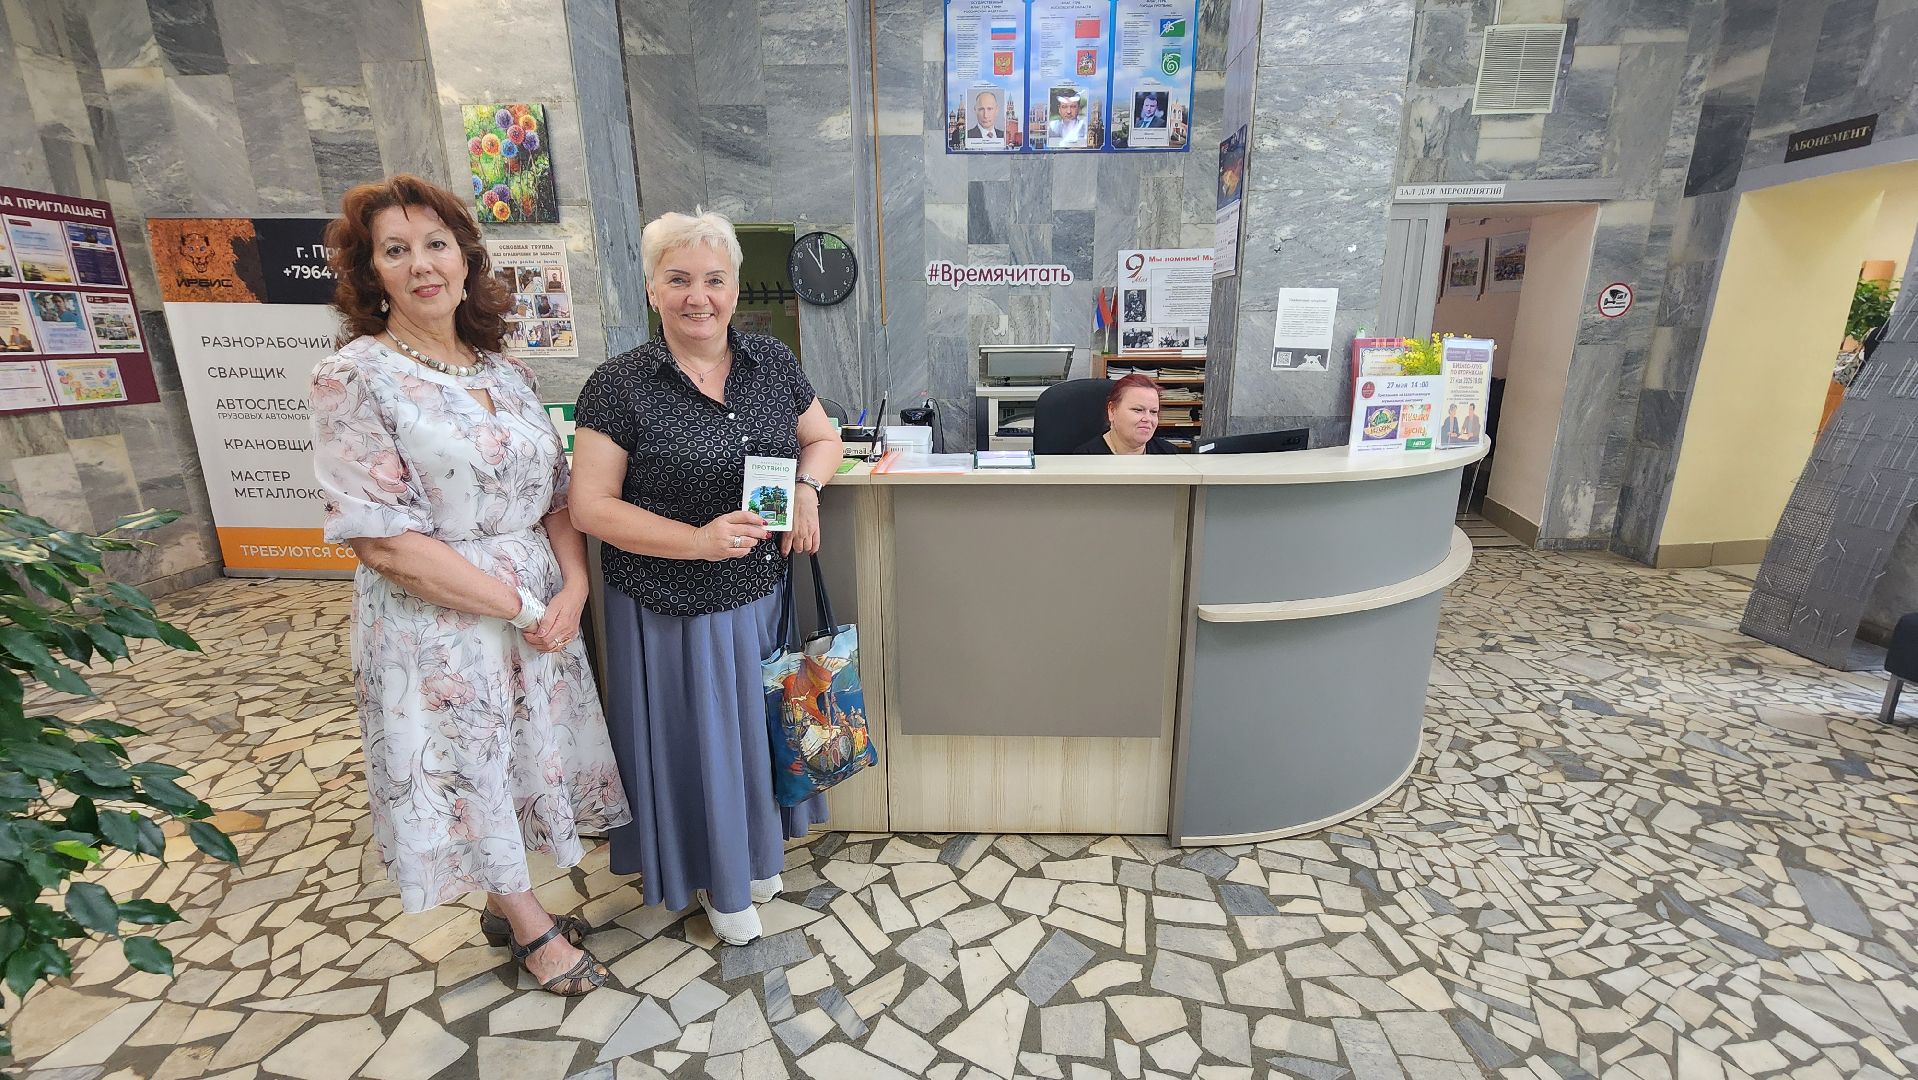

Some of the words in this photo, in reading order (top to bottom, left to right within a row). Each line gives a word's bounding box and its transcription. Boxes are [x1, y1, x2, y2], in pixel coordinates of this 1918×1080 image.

[1791, 125, 1871, 153] АБОНЕМЕНТ
[1399, 188, 1416, 196] ЗАЛ
[1418, 188, 1436, 196] ДЛЯ
[1440, 187, 1502, 195] МЕРОПРИЯТИЙ
[16, 197, 107, 219] ПРИГЛАШАЕТ
[296, 246, 309, 259] г.
[312, 244, 339, 261] Пр
[283, 265, 338, 279] +7964
[1125, 253, 1145, 279] 9
[928, 263, 1071, 287] #Времячитать
[176, 278, 233, 287] ИРБИС
[201, 334, 332, 349] РАЗНОРАБОЧИЙ
[207, 367, 287, 381] СВАРЩИК
[1386, 381, 1395, 389] 27
[216, 398, 310, 411] АВТОСЛЕСА
[218, 412, 263, 420] ГРУЗОВЫХ
[230, 470, 291, 482] МАСТЕР
[239, 545, 332, 558] ТРЕБУЮТСЯ
